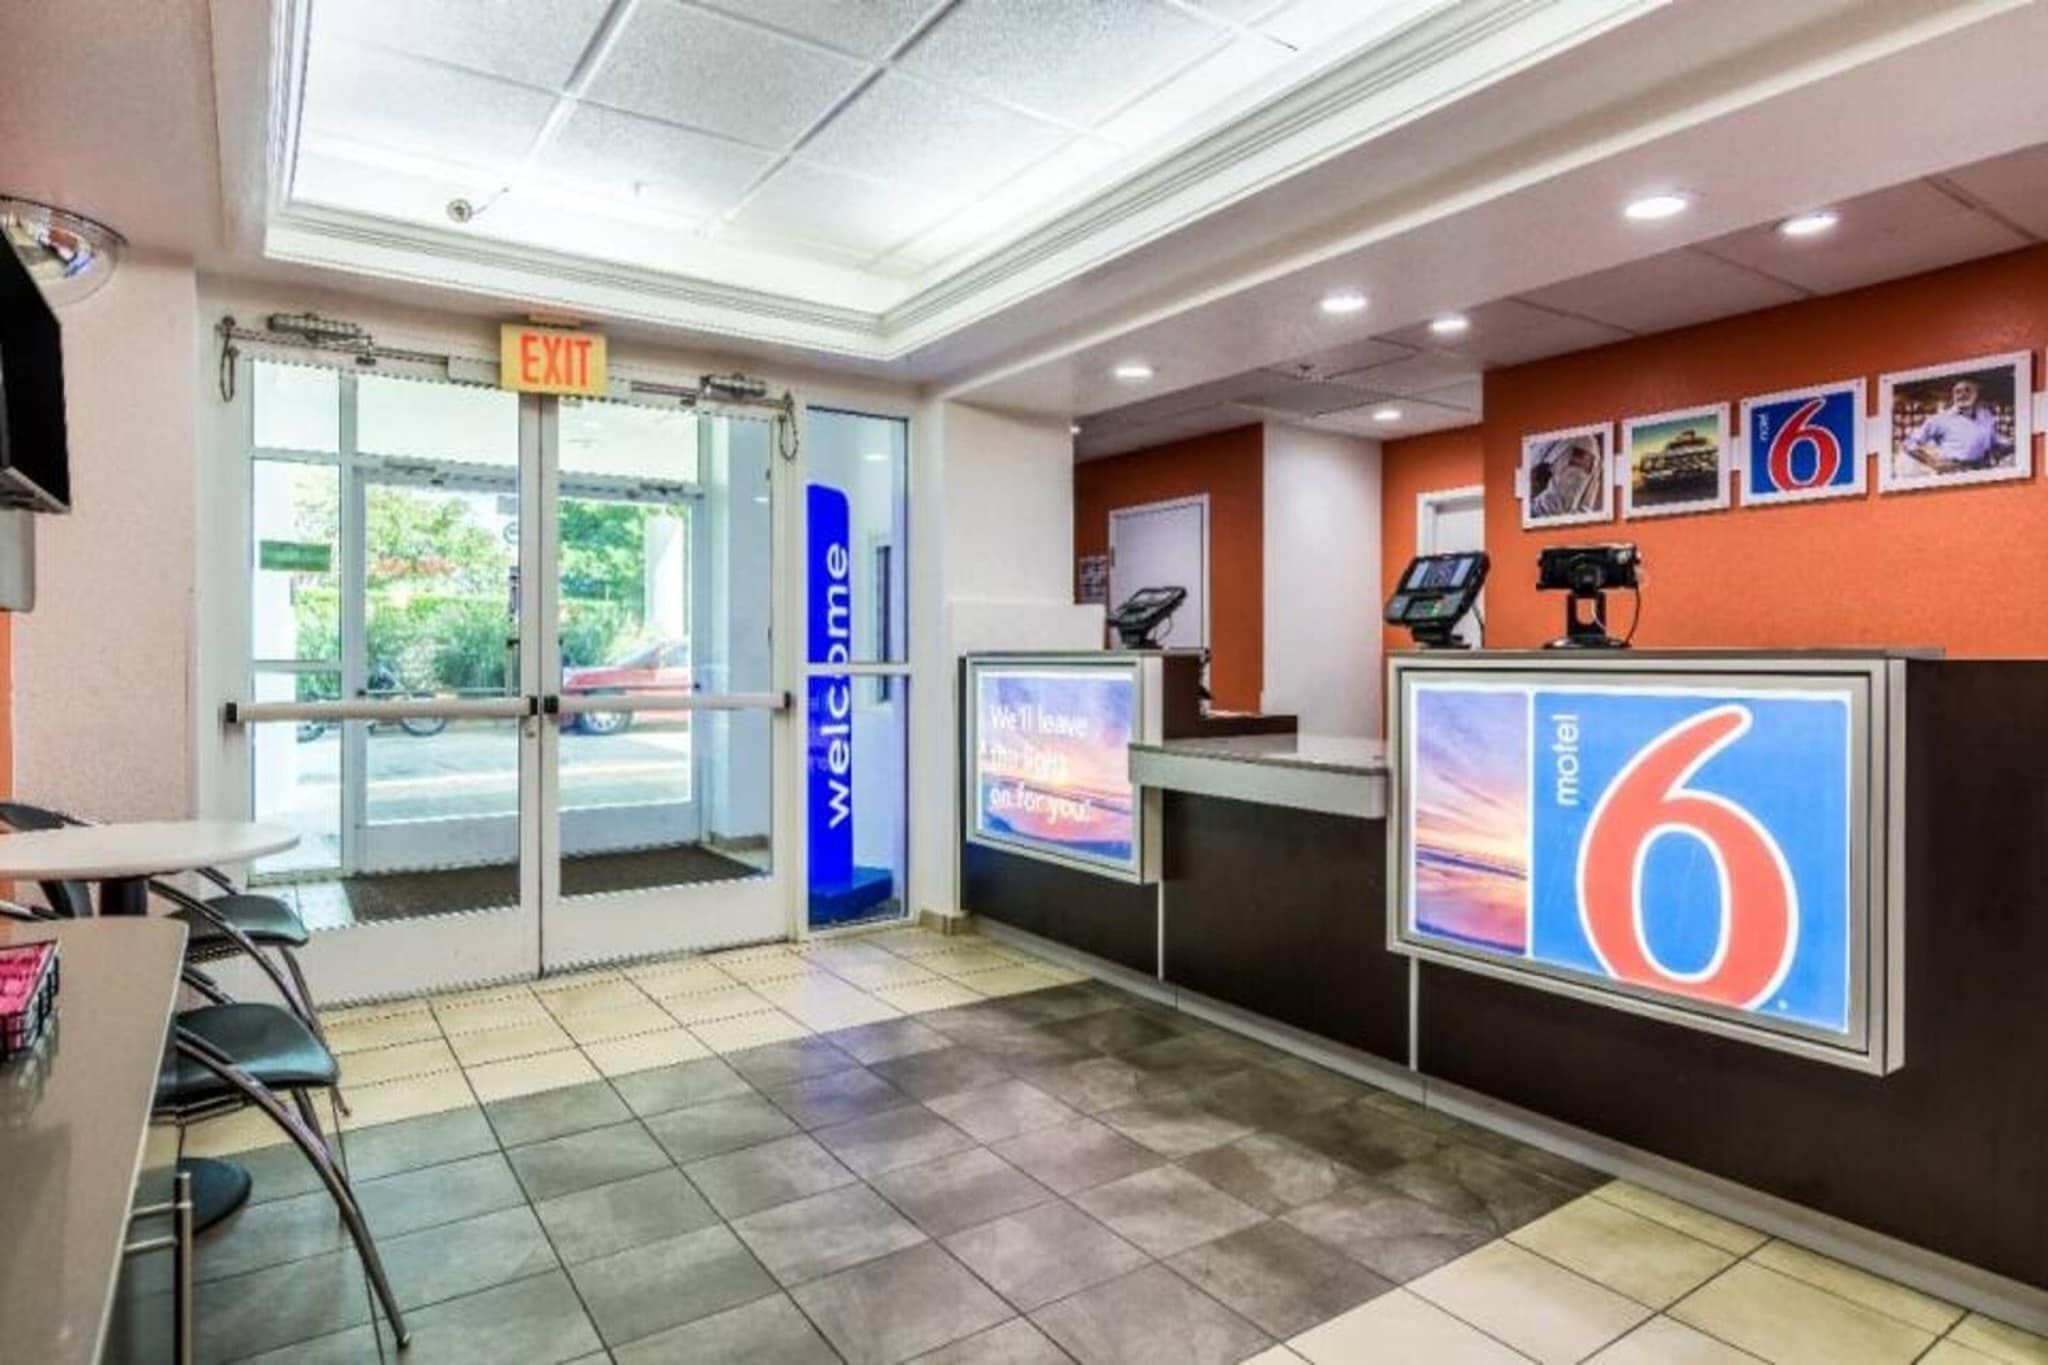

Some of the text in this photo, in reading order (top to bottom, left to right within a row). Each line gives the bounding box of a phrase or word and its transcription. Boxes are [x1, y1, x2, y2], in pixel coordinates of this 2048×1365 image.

[520, 333, 592, 387] EXIT
[1768, 397, 1841, 493] 6
[820, 542, 851, 829] welcome
[990, 787, 1010, 810] on
[1016, 780, 1043, 812] for
[1552, 713, 1580, 807] motel
[1576, 703, 1800, 1012] 6
